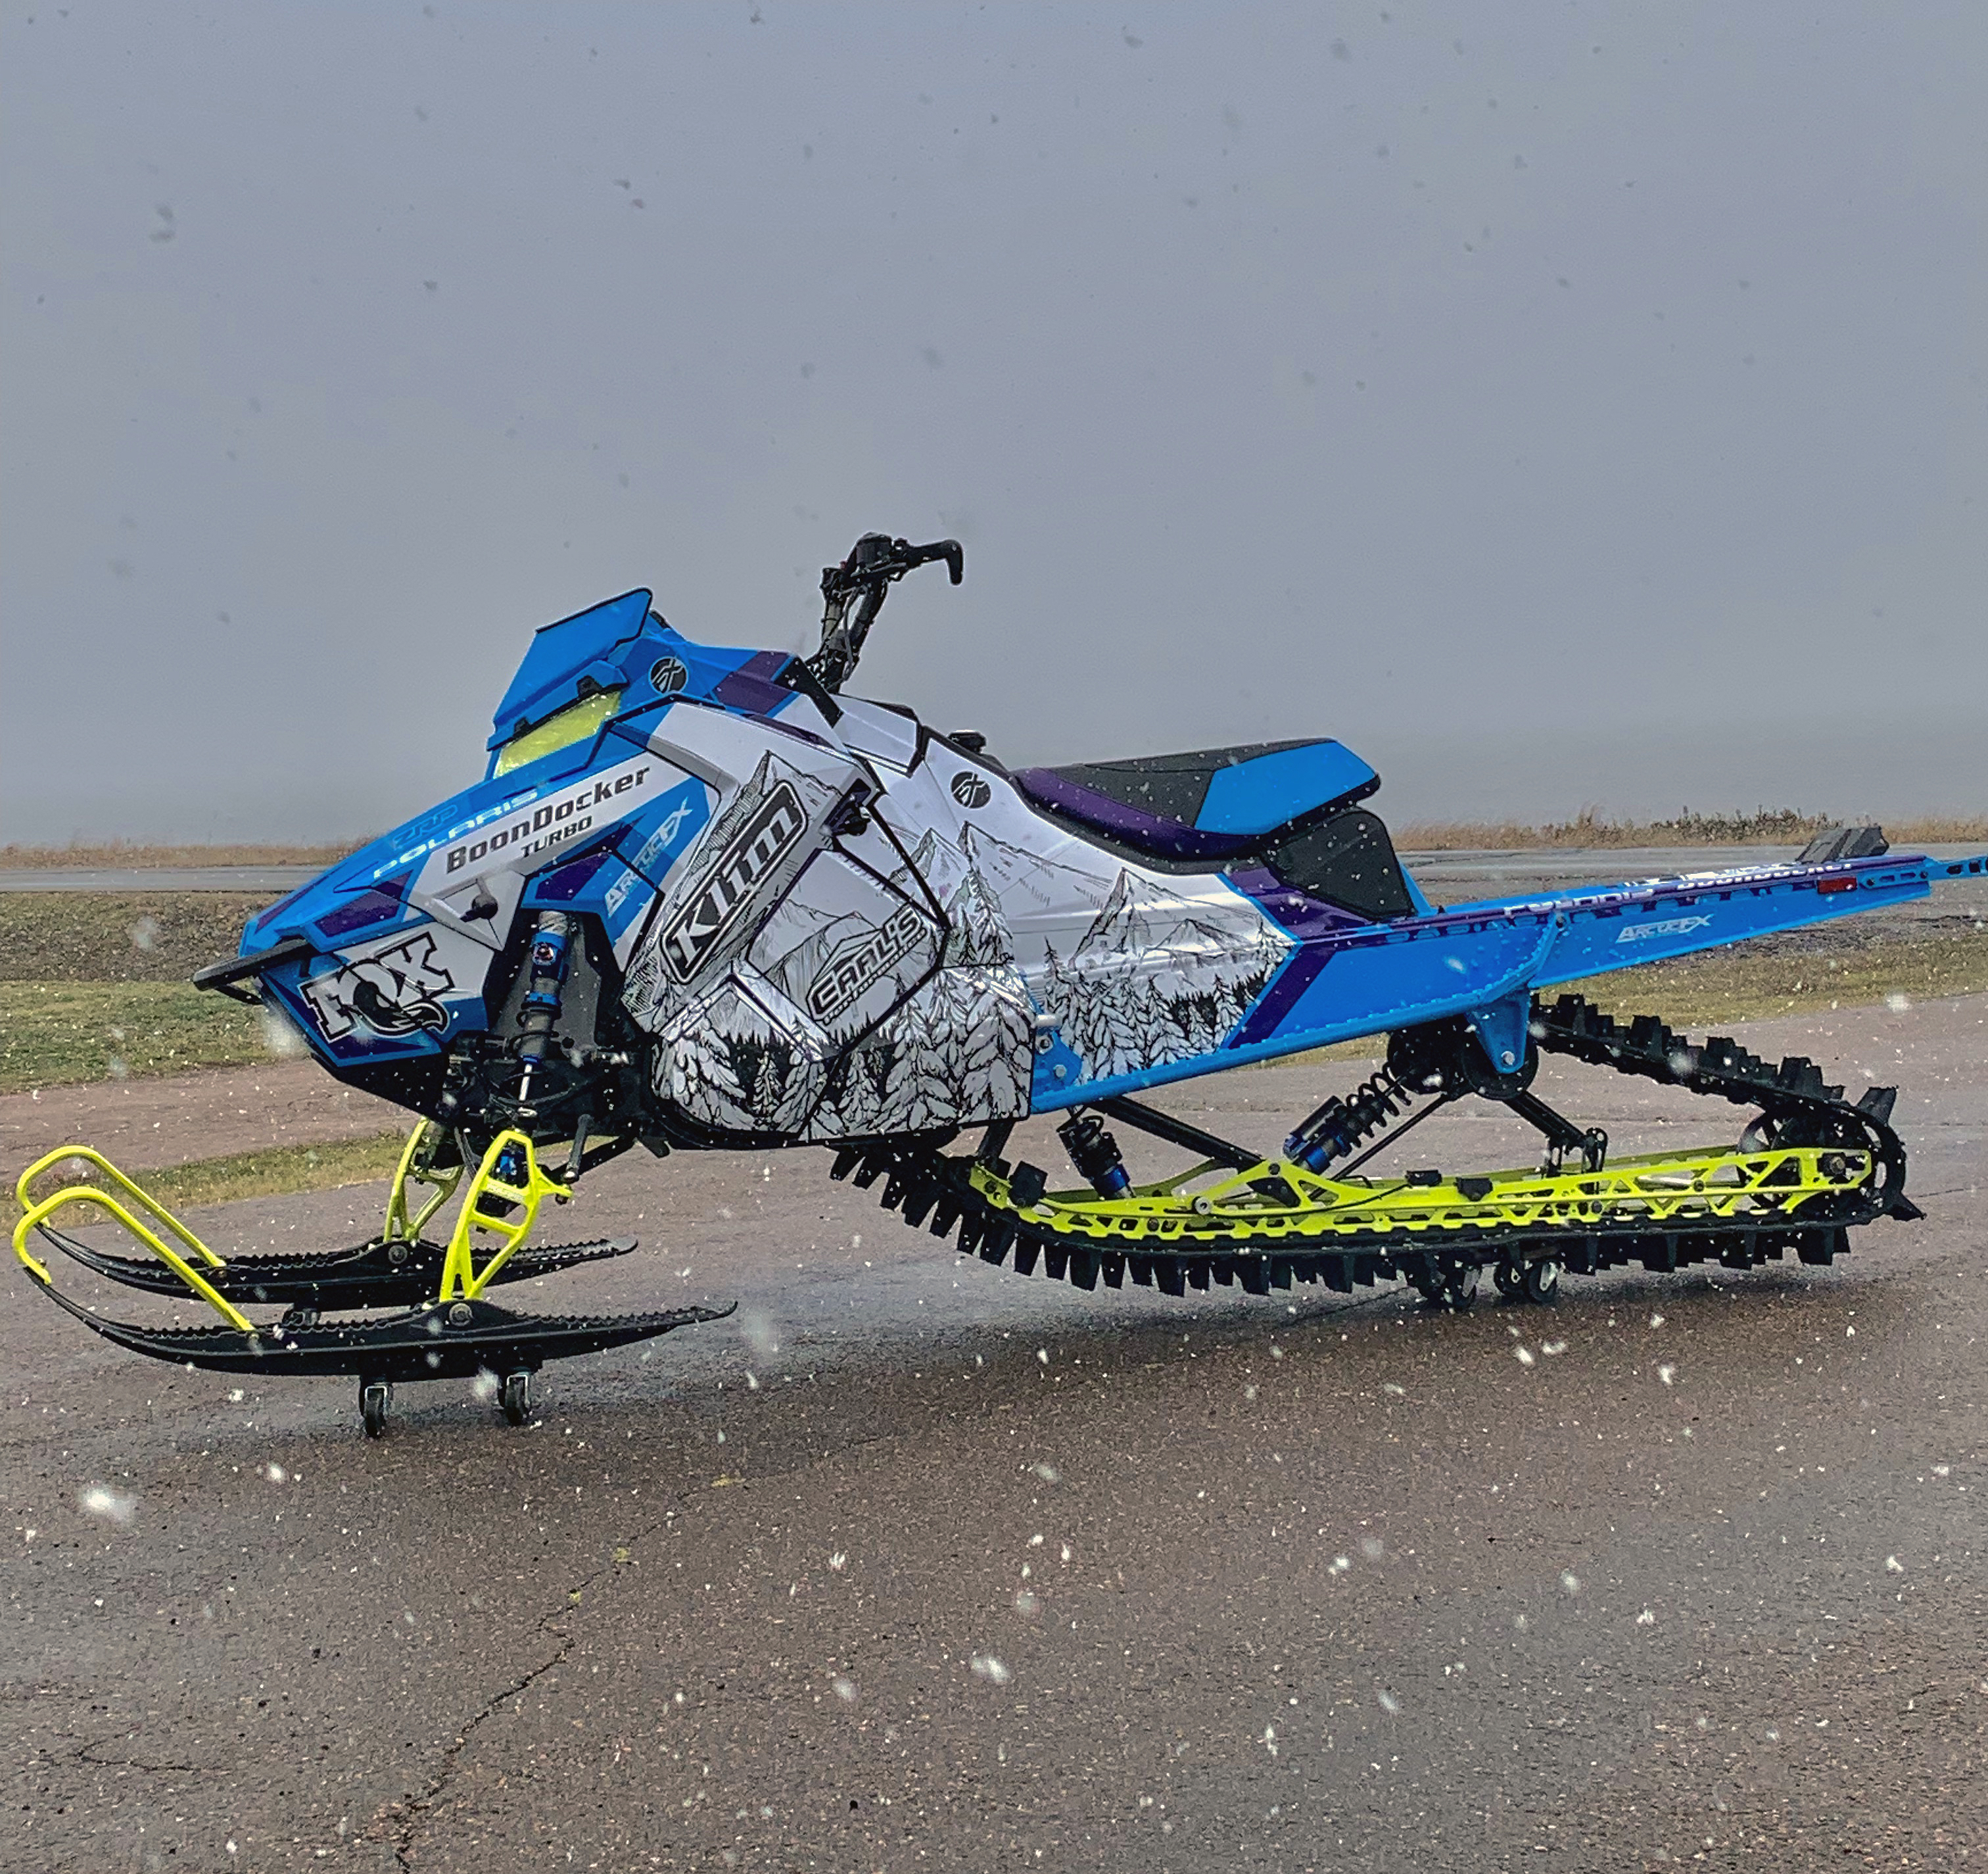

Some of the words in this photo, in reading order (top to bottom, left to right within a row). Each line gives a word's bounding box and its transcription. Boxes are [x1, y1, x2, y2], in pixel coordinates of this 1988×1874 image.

[373, 790, 538, 879] POLARIS
[446, 765, 650, 875] BoonDocker
[520, 815, 593, 859] TURBO
[297, 930, 456, 1044] FOX
